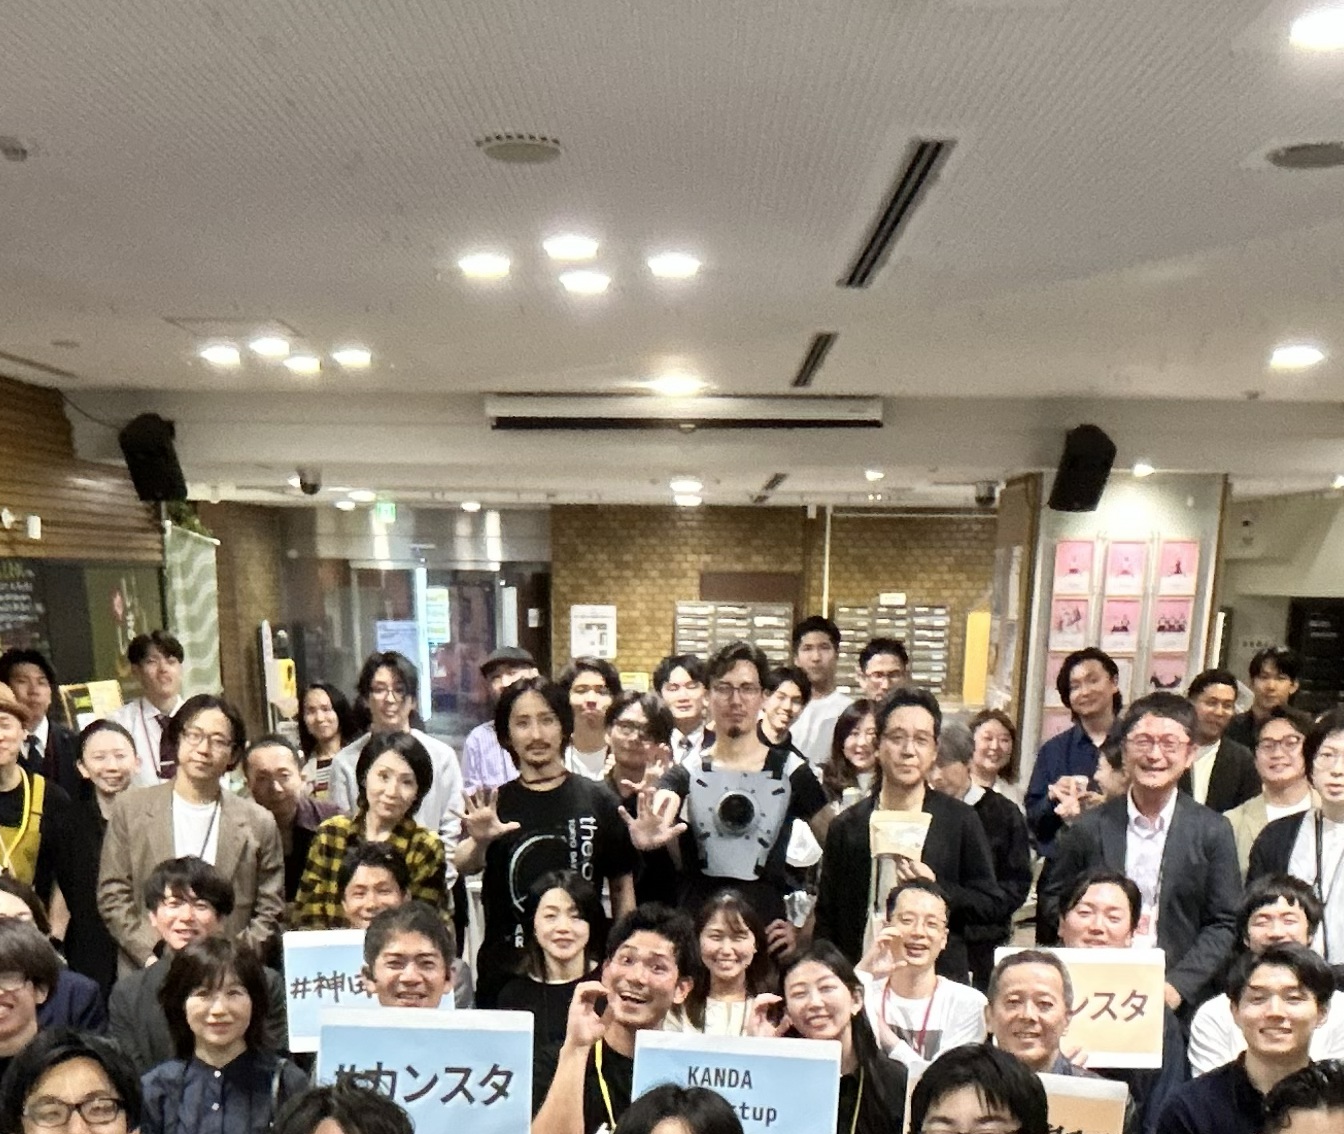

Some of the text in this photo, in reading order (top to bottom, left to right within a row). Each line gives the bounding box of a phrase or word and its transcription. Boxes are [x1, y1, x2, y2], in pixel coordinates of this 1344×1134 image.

[1067, 989, 1148, 1022] ンスタ
[688, 1066, 753, 1090] KANDA
